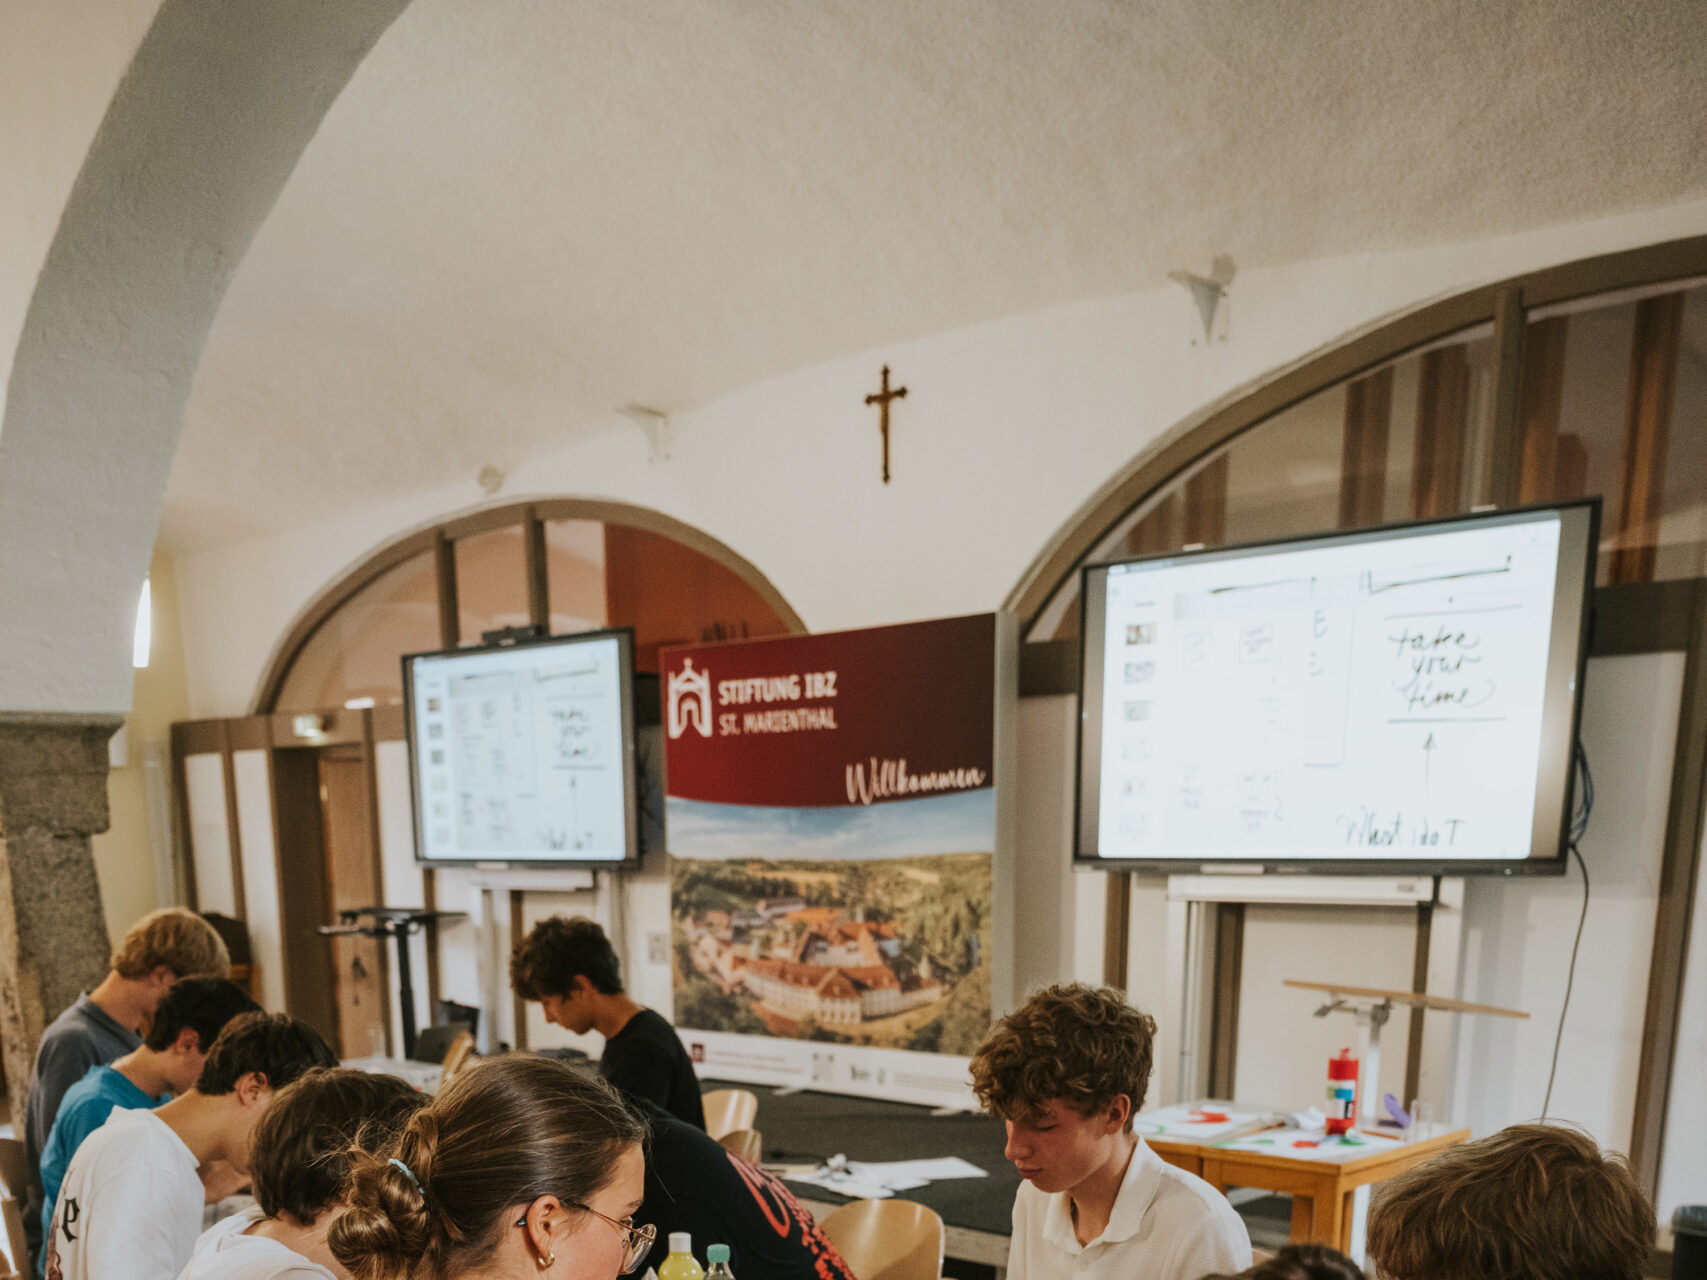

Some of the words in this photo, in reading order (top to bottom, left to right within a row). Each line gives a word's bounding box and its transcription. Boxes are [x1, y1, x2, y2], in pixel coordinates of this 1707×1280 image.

[718, 674, 801, 706] STIFTUNG
[804, 670, 838, 699] IBZ
[719, 713, 741, 736] ST.
[743, 707, 838, 734] MARIENTHAL
[846, 756, 987, 806] Willkommen
